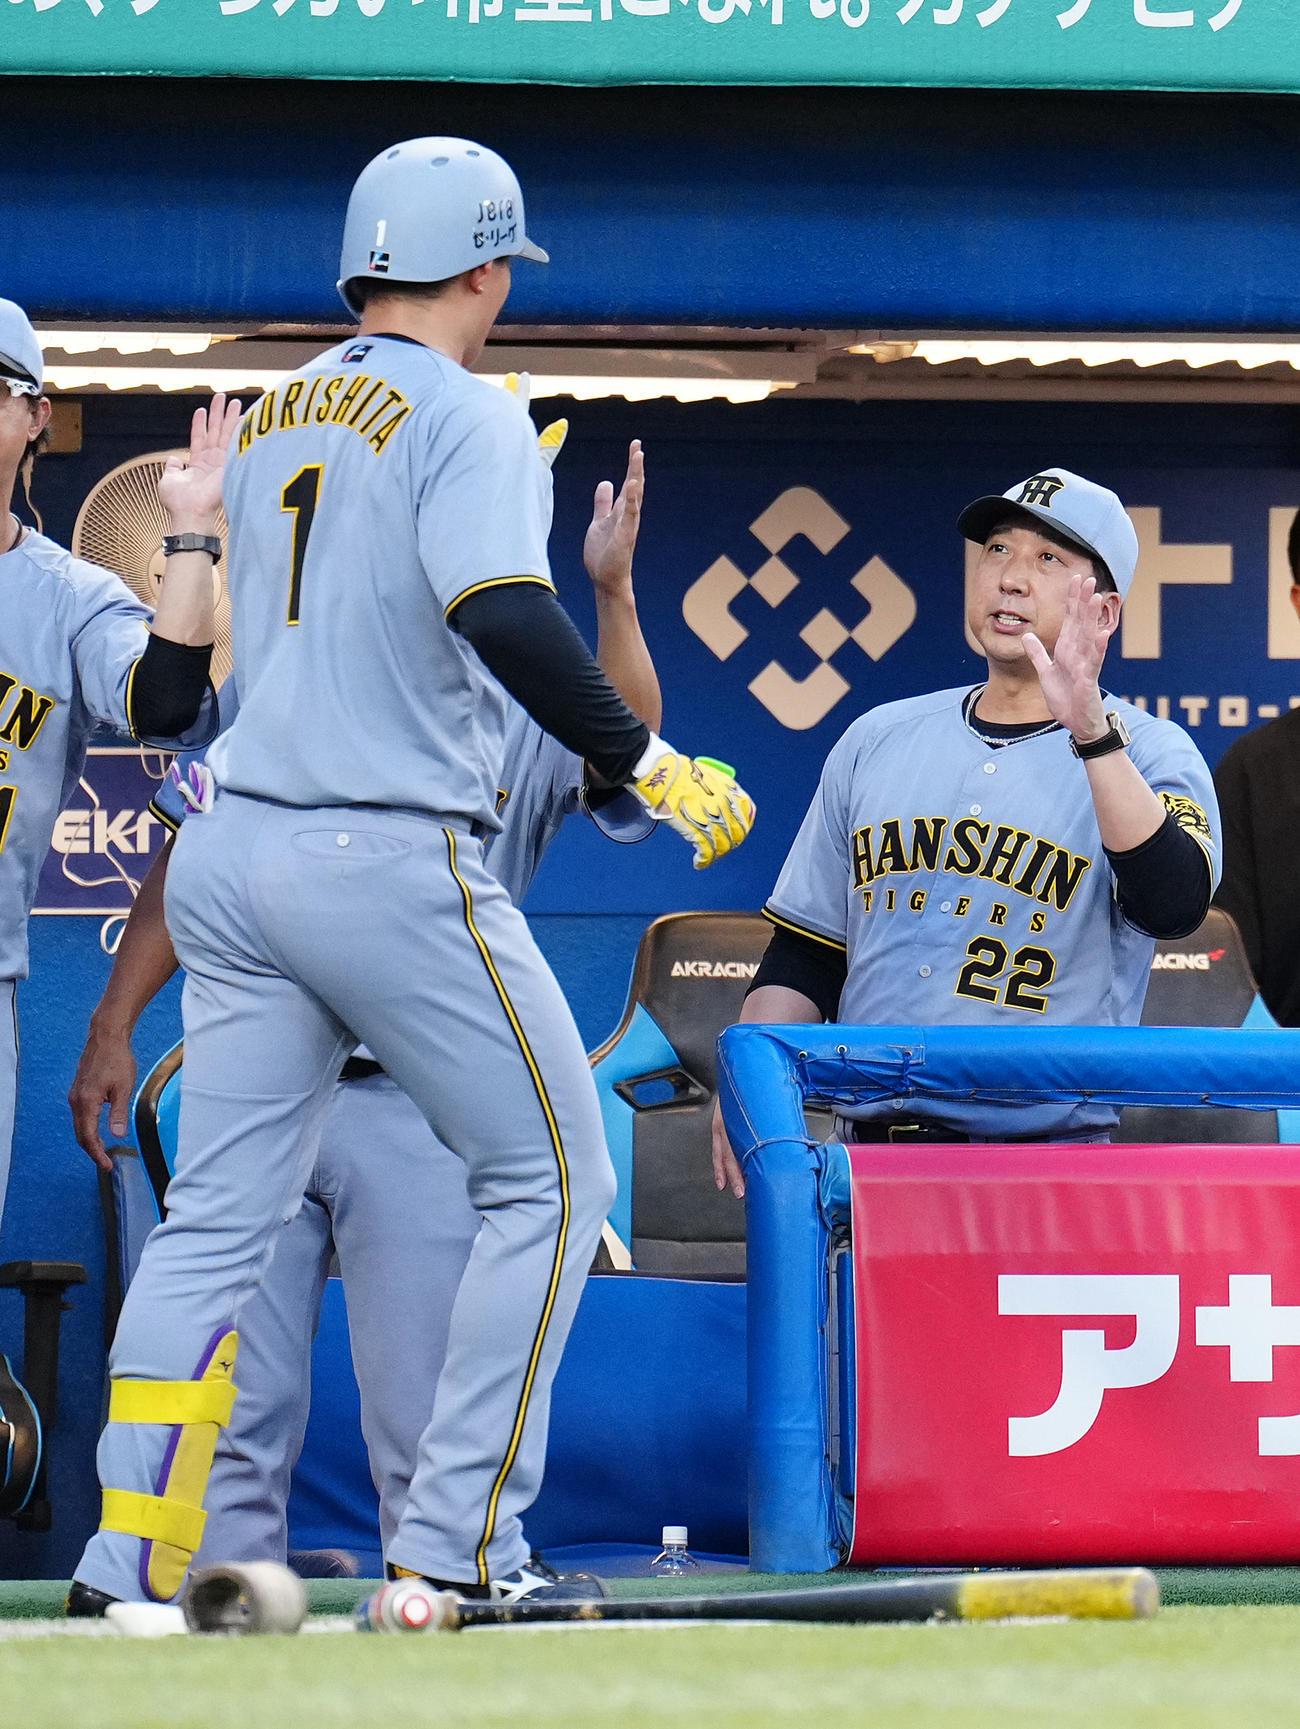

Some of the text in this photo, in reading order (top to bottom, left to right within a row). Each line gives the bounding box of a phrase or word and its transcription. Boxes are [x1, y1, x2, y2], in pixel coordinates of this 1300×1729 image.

[375, 219, 387, 248] 1
[238, 375, 413, 457] MORISHITA
[280, 463, 325, 627] 1
[853, 816, 1091, 912] HANSHIN
[863, 888, 1047, 933] TIGERS
[953, 935, 1057, 1014] 22
